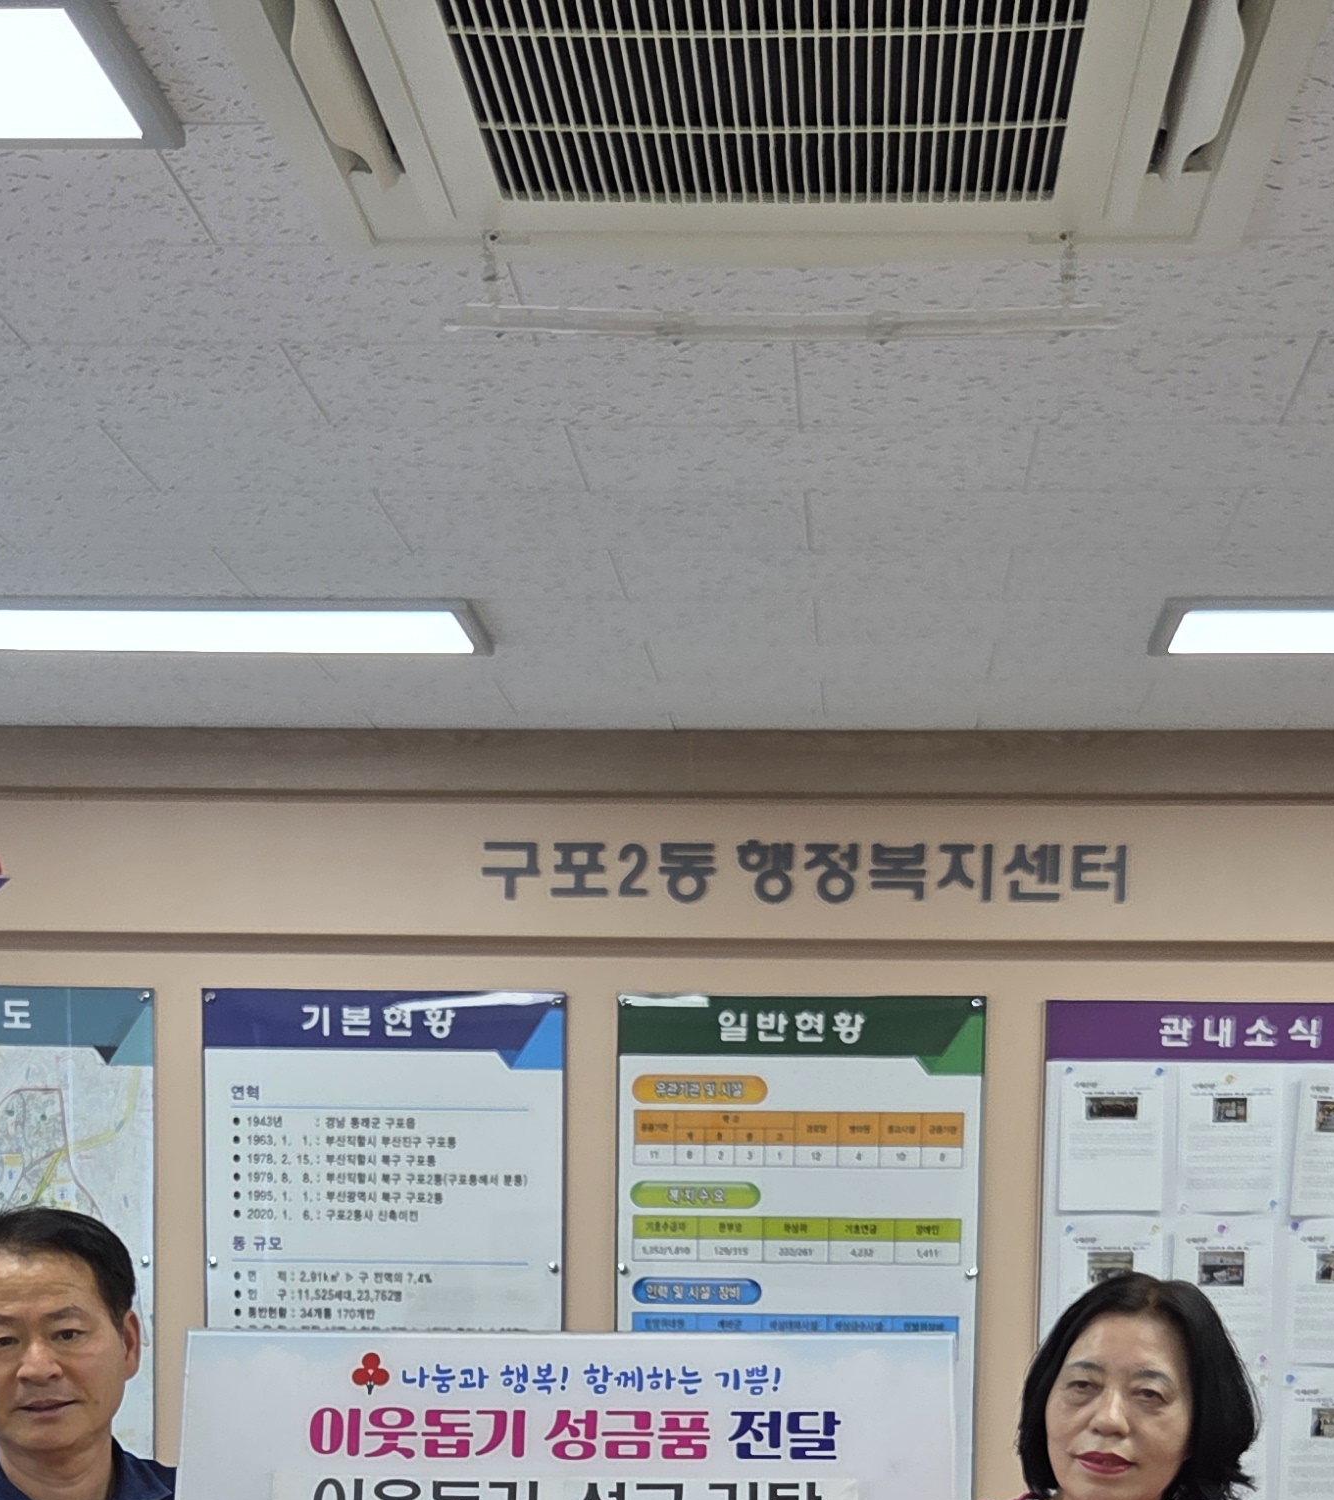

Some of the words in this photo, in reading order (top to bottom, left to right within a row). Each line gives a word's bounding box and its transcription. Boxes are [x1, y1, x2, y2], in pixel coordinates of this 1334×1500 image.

[481, 839, 717, 903] 구포2동
[738, 839, 1129, 904] 행정복지센터
[301, 1003, 457, 1039] 기본현황
[718, 1010, 866, 1045] 일반현황
[1160, 1014, 1323, 1049] 관내소식
[401, 1364, 488, 1392] 나눔과
[506, 1363, 567, 1393] 행복!
[584, 1363, 702, 1394] 함께하는
[713, 1363, 781, 1394] 기쁨!
[309, 1407, 525, 1460] 이웃돕기
[546, 1408, 710, 1460] 성금품
[728, 1408, 841, 1461] 전달
